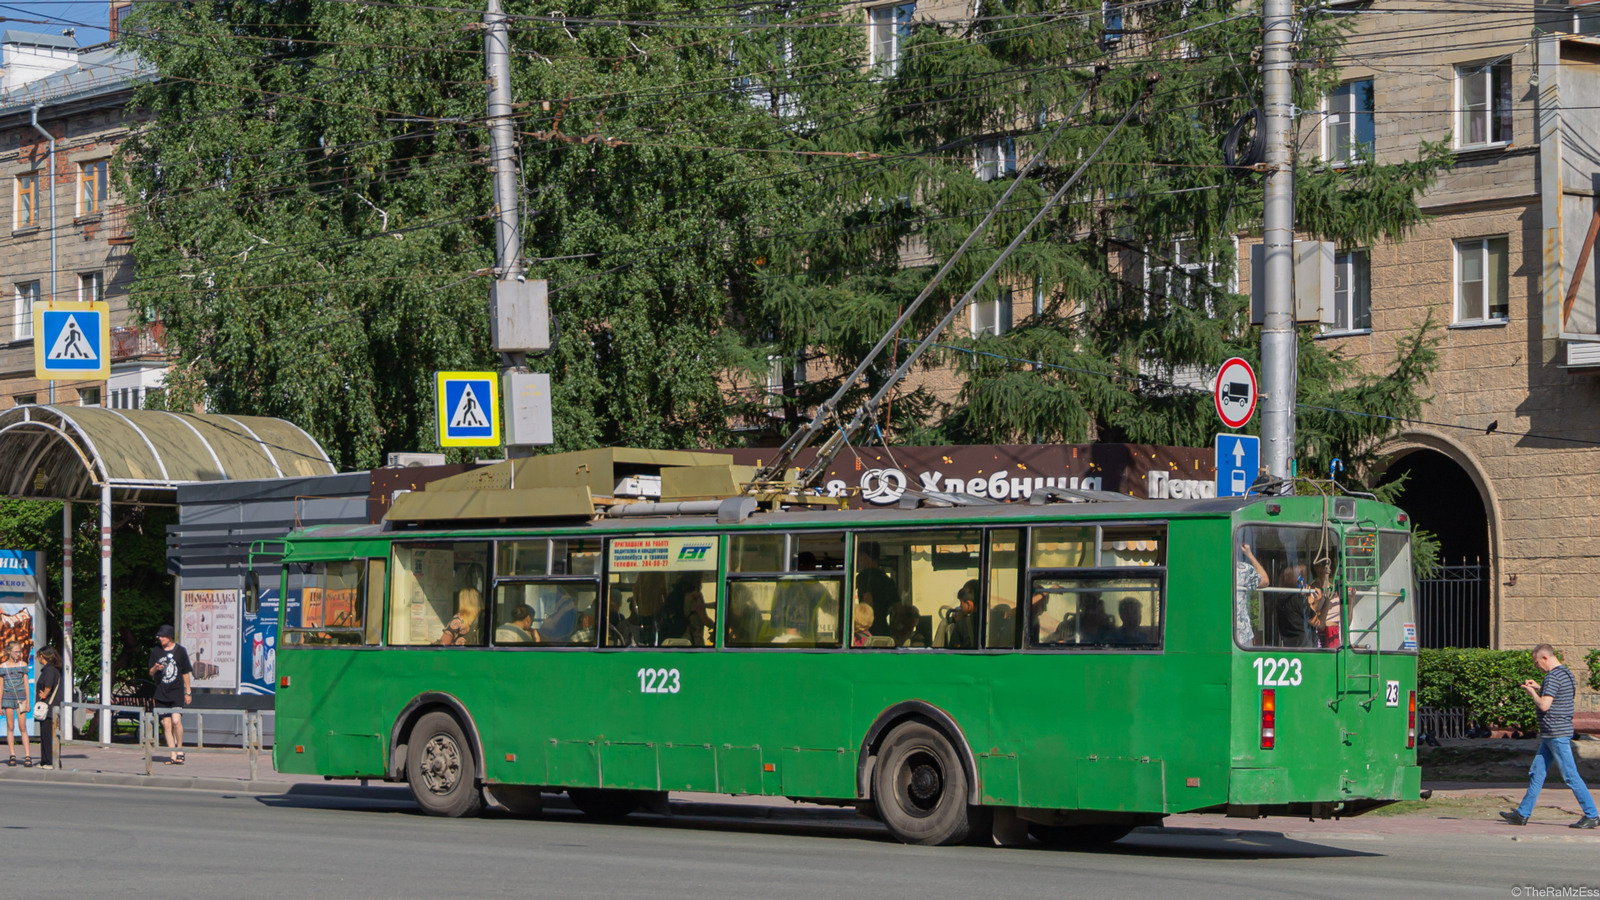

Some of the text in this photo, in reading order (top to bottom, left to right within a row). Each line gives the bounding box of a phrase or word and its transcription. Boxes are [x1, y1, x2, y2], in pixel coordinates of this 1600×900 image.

[637, 668, 680, 693] 1223
[1253, 657, 1302, 686] 1223
[1387, 684, 1398, 702] 23
